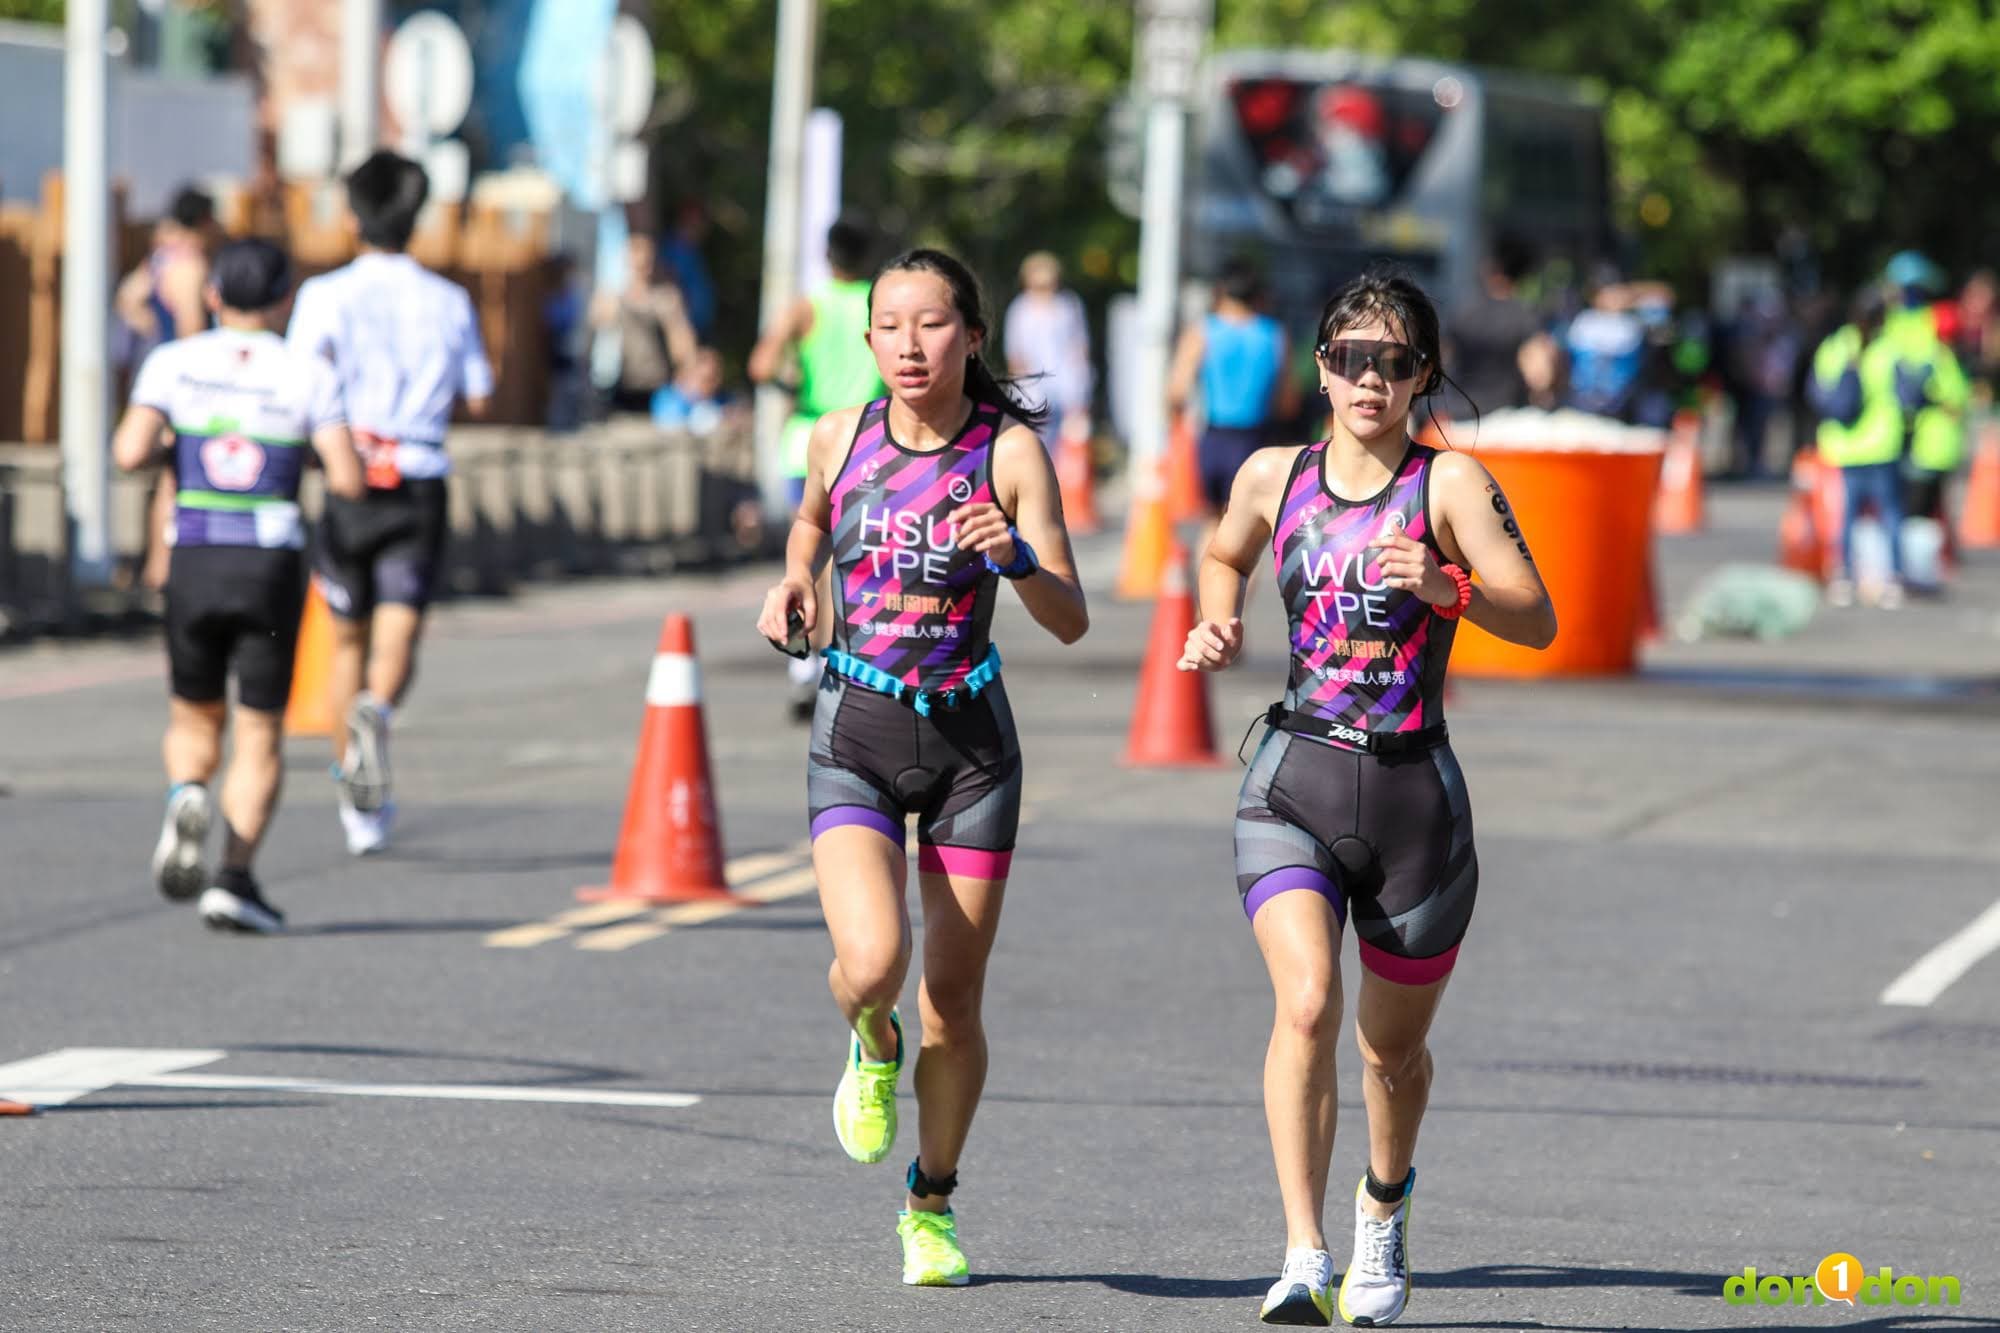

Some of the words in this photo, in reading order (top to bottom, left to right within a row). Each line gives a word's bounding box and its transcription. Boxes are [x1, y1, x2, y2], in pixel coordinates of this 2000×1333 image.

[859, 503, 956, 553] HSU
[861, 545, 950, 585] TPE
[1301, 549, 1388, 592] WU
[1305, 590, 1390, 627] TPE
